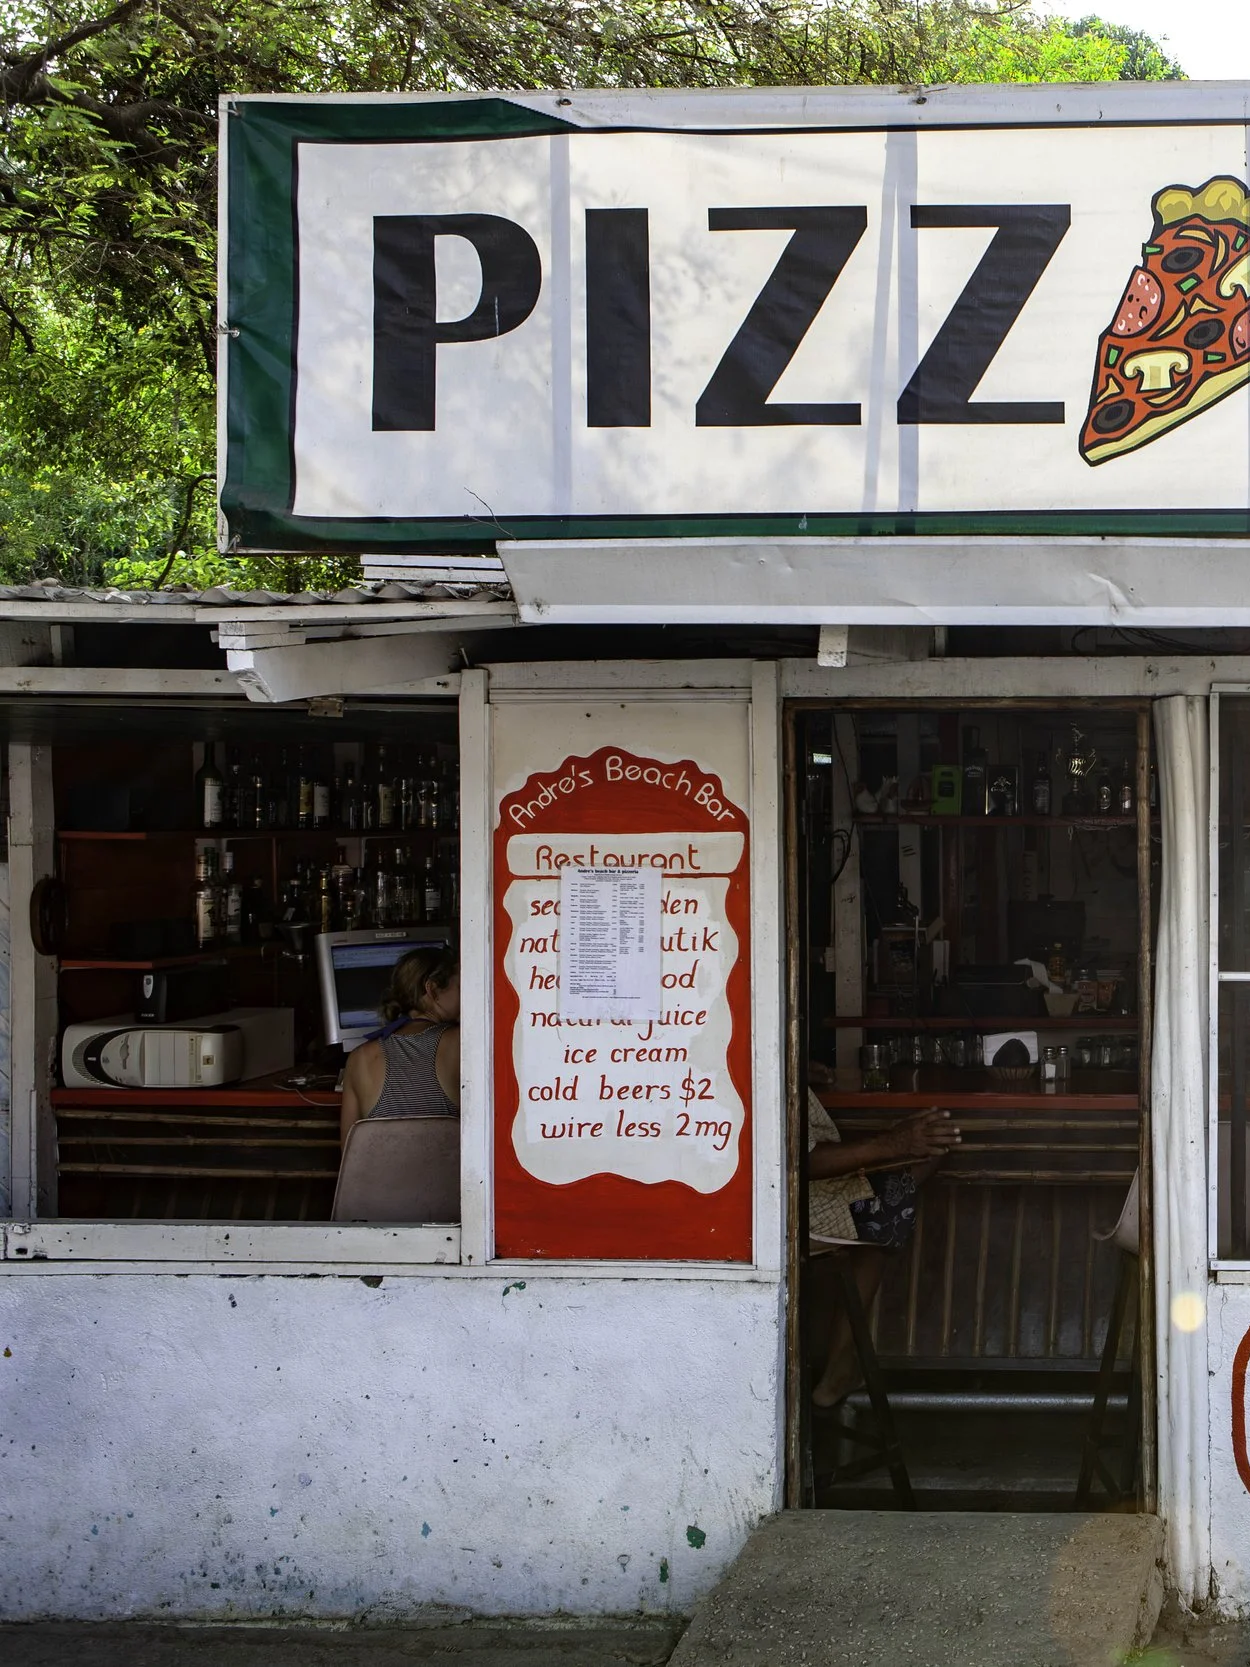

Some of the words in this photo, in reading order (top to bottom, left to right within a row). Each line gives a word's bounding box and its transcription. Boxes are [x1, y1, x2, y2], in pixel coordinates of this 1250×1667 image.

[508, 764, 594, 828] Andre's
[605, 755, 692, 796] Beach
[693, 782, 736, 821] Bar
[536, 843, 701, 871] Restaurant
[563, 1044, 597, 1064] ice
[610, 1046, 688, 1063] cream
[528, 1075, 579, 1101] cold
[599, 1074, 671, 1100] beers
[679, 1066, 715, 1108] $2
[540, 1116, 604, 1139] wire
[616, 1109, 662, 1138] less
